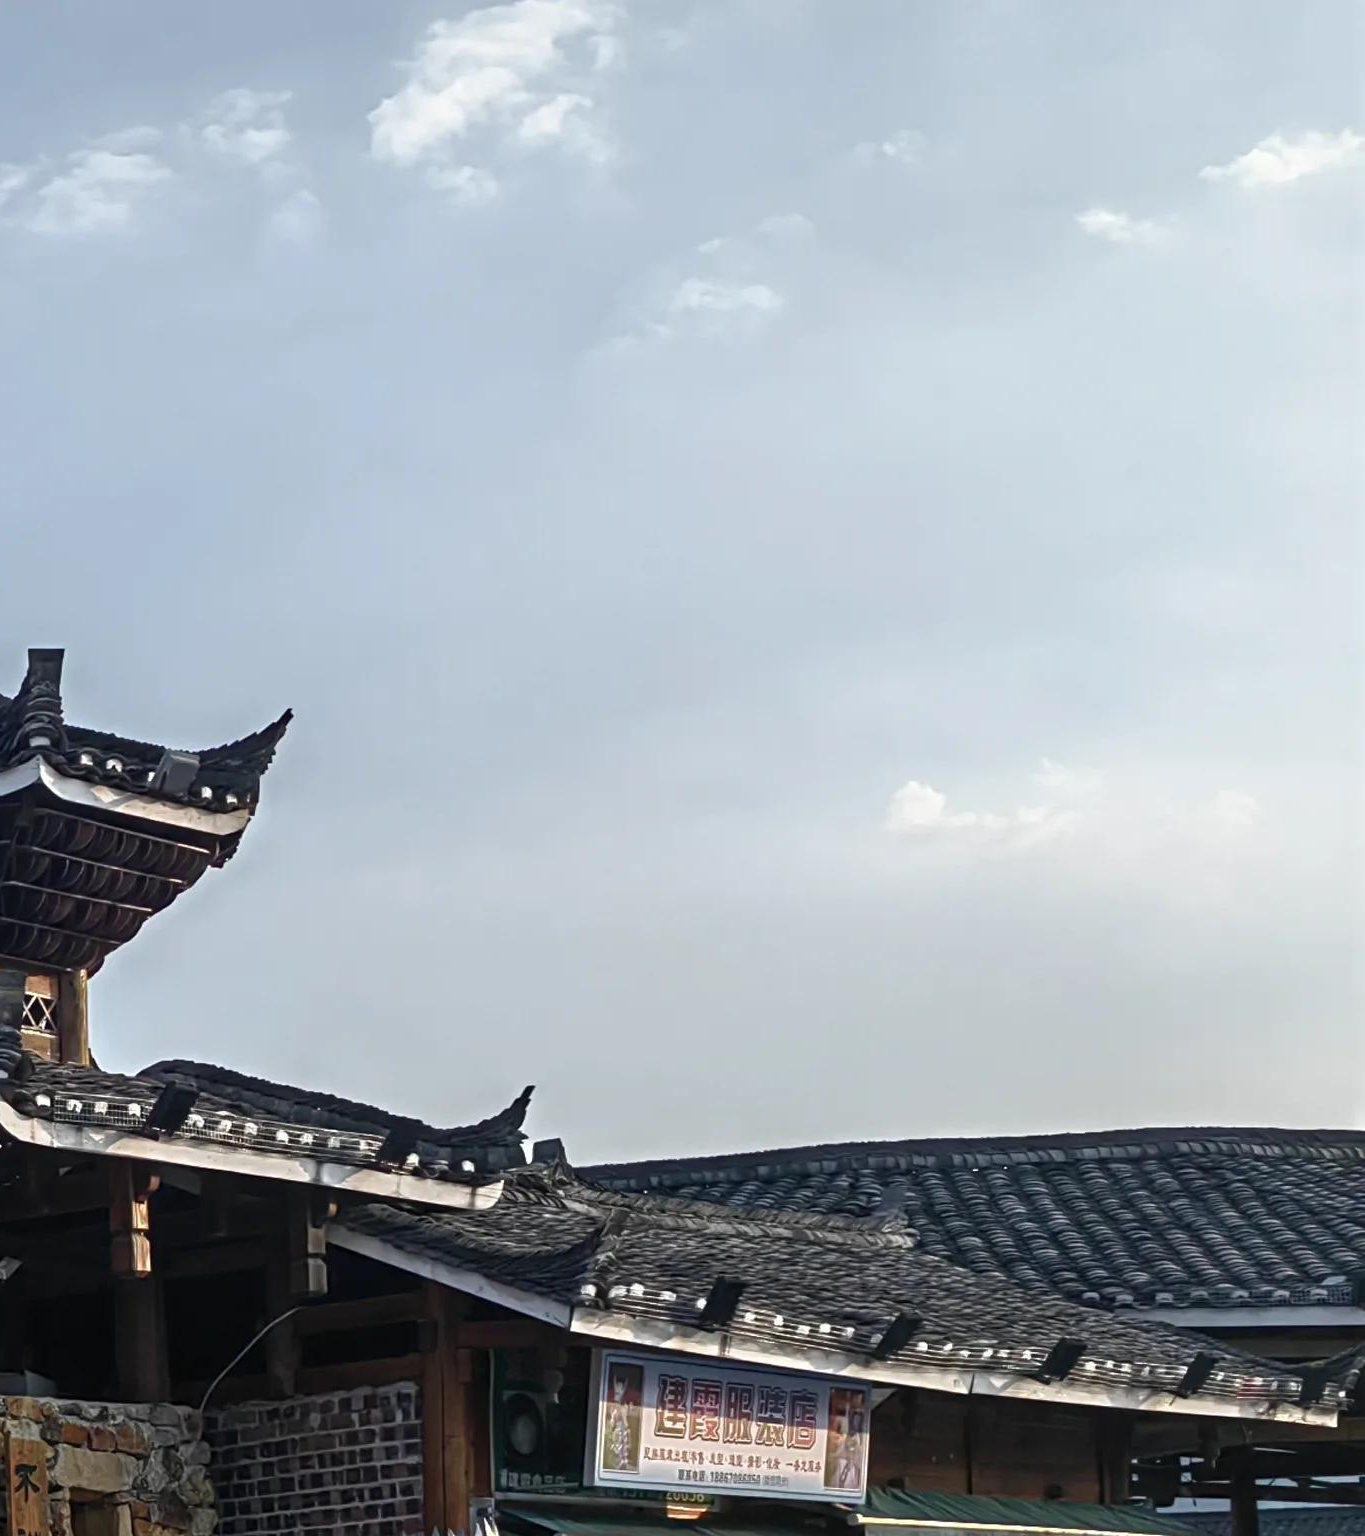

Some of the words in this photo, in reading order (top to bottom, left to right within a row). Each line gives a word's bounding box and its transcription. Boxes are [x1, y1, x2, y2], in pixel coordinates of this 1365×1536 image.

[654, 1374, 819, 1450] 建霞服装店
